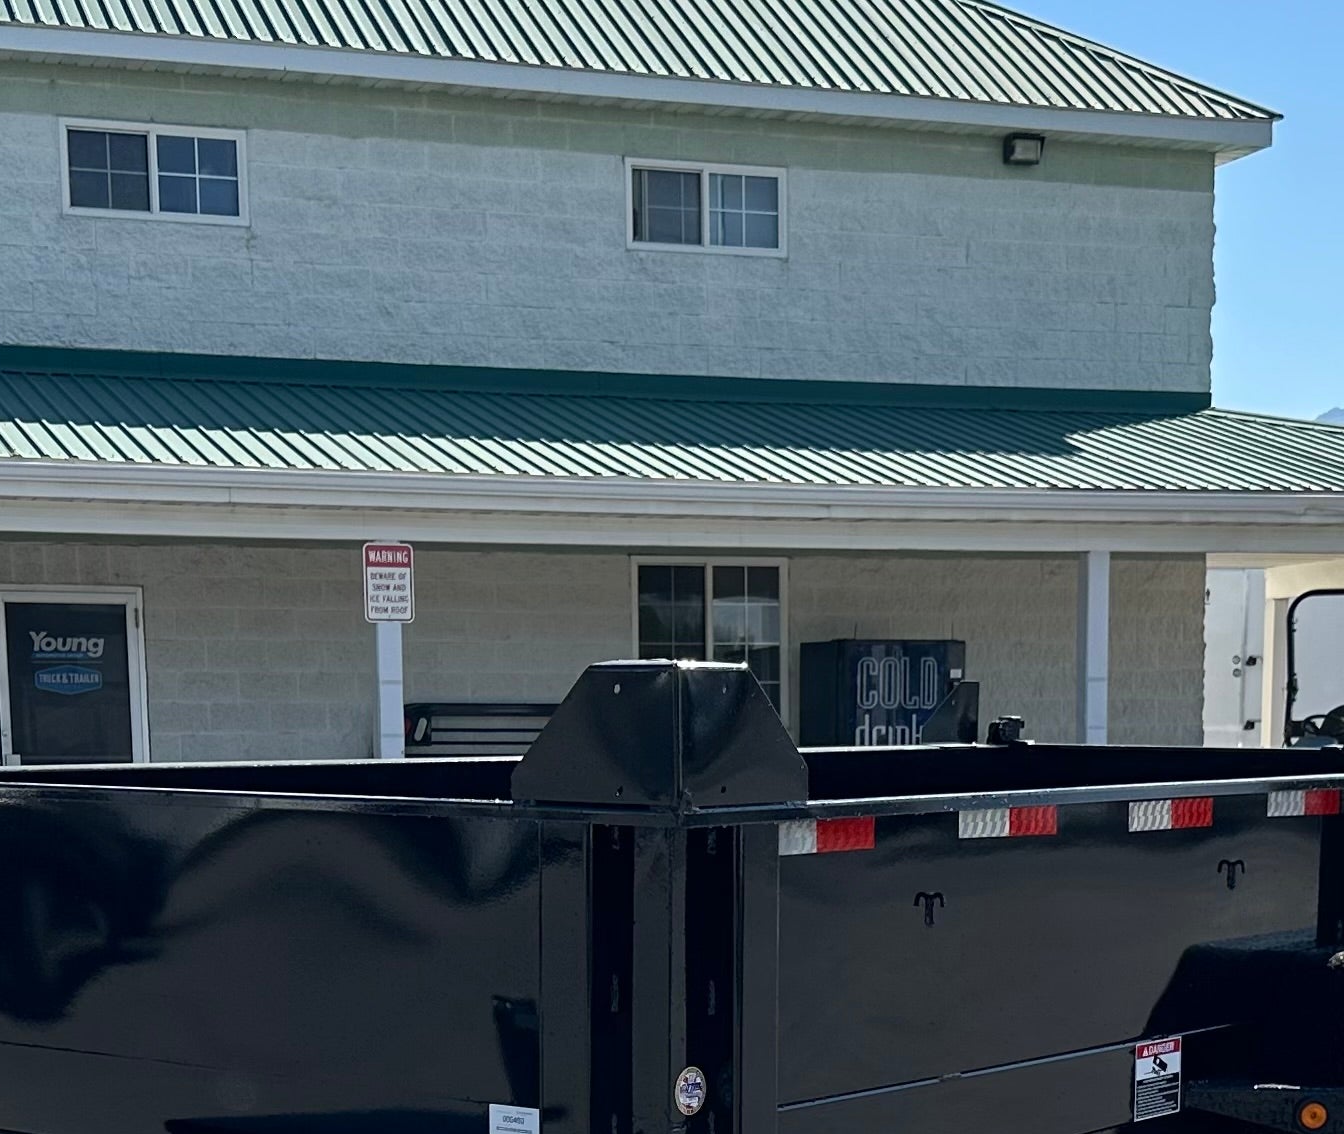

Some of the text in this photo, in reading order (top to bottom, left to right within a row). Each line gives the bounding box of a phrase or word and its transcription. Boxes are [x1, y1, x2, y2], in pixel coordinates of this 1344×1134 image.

[368, 550, 409, 564] WARNING
[370, 572, 396, 580] BEWARE
[29, 631, 105, 658] Young
[856, 656, 938, 710] COLD
